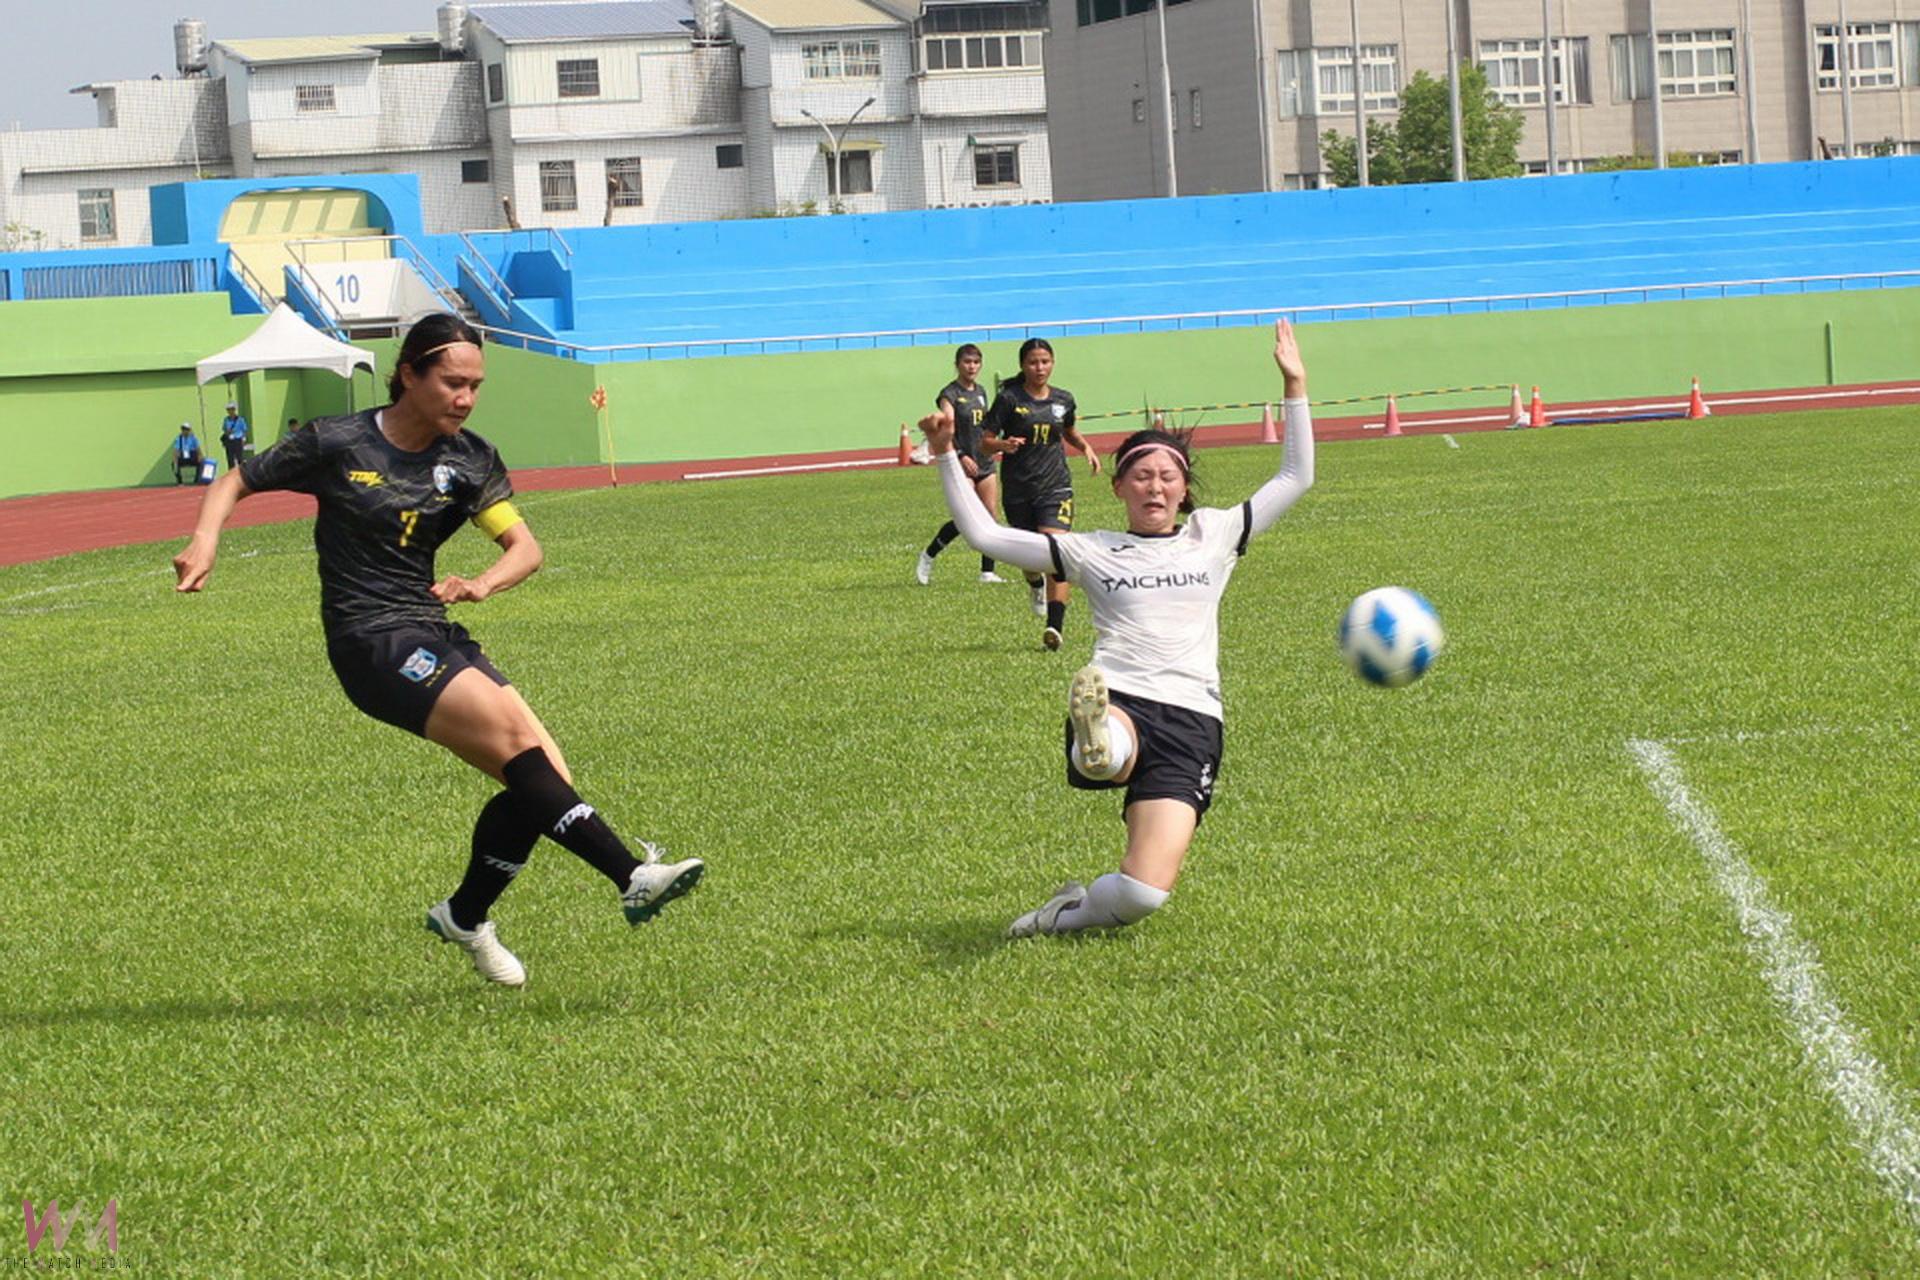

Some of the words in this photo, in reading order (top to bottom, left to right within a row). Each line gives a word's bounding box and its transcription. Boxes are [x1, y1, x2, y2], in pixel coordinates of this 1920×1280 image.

[336, 274, 360, 303] 10
[1033, 423, 1051, 445] 19
[400, 510, 418, 547] 7
